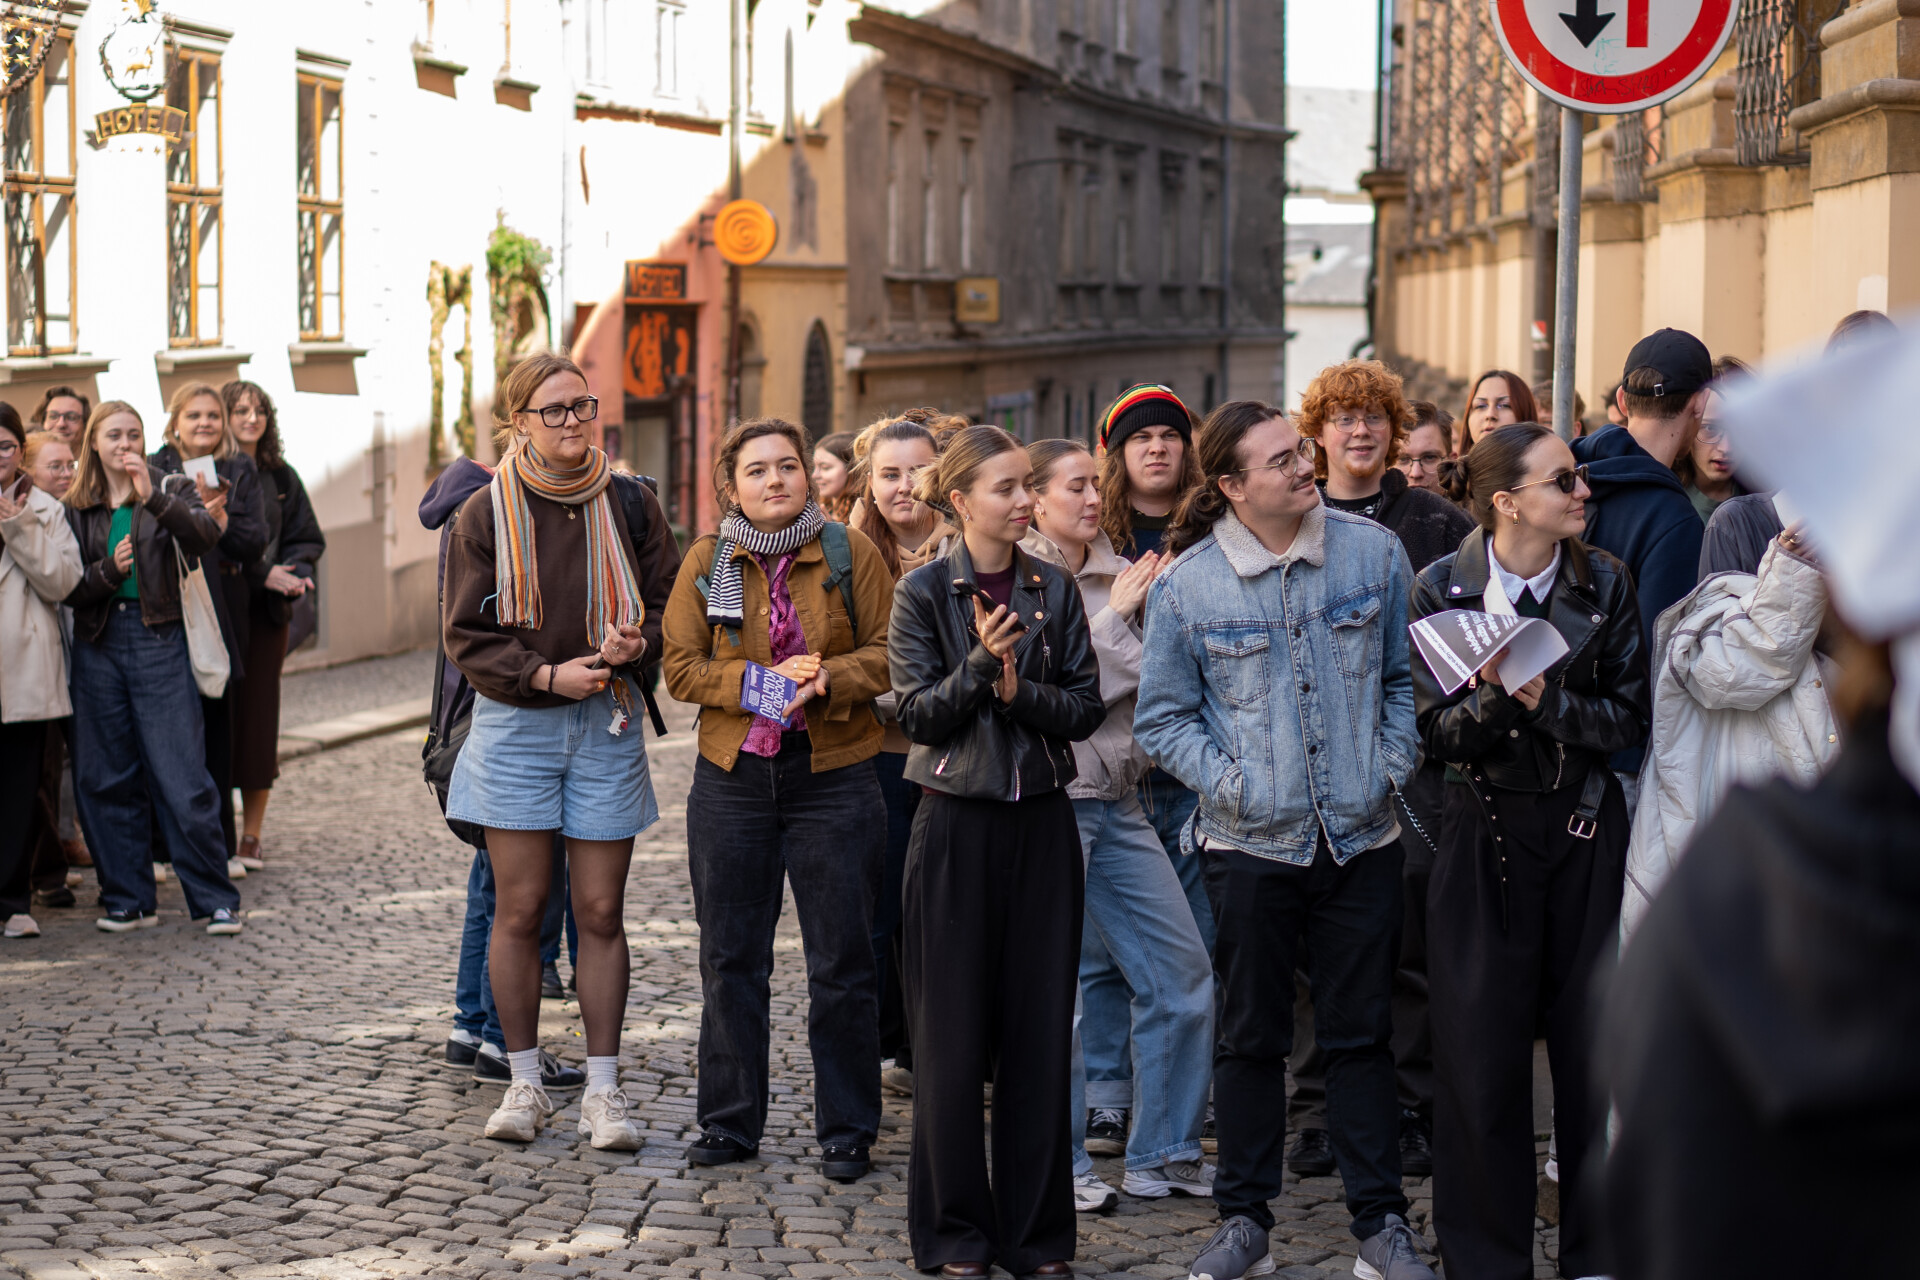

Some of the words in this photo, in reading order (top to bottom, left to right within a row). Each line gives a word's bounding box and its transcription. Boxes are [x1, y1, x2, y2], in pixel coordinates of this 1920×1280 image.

[100, 107, 176, 138] HOTEL
[759, 670, 777, 718] KULTURU
[773, 674, 785, 708] POCHOD
[771, 708, 781, 719] ZA
